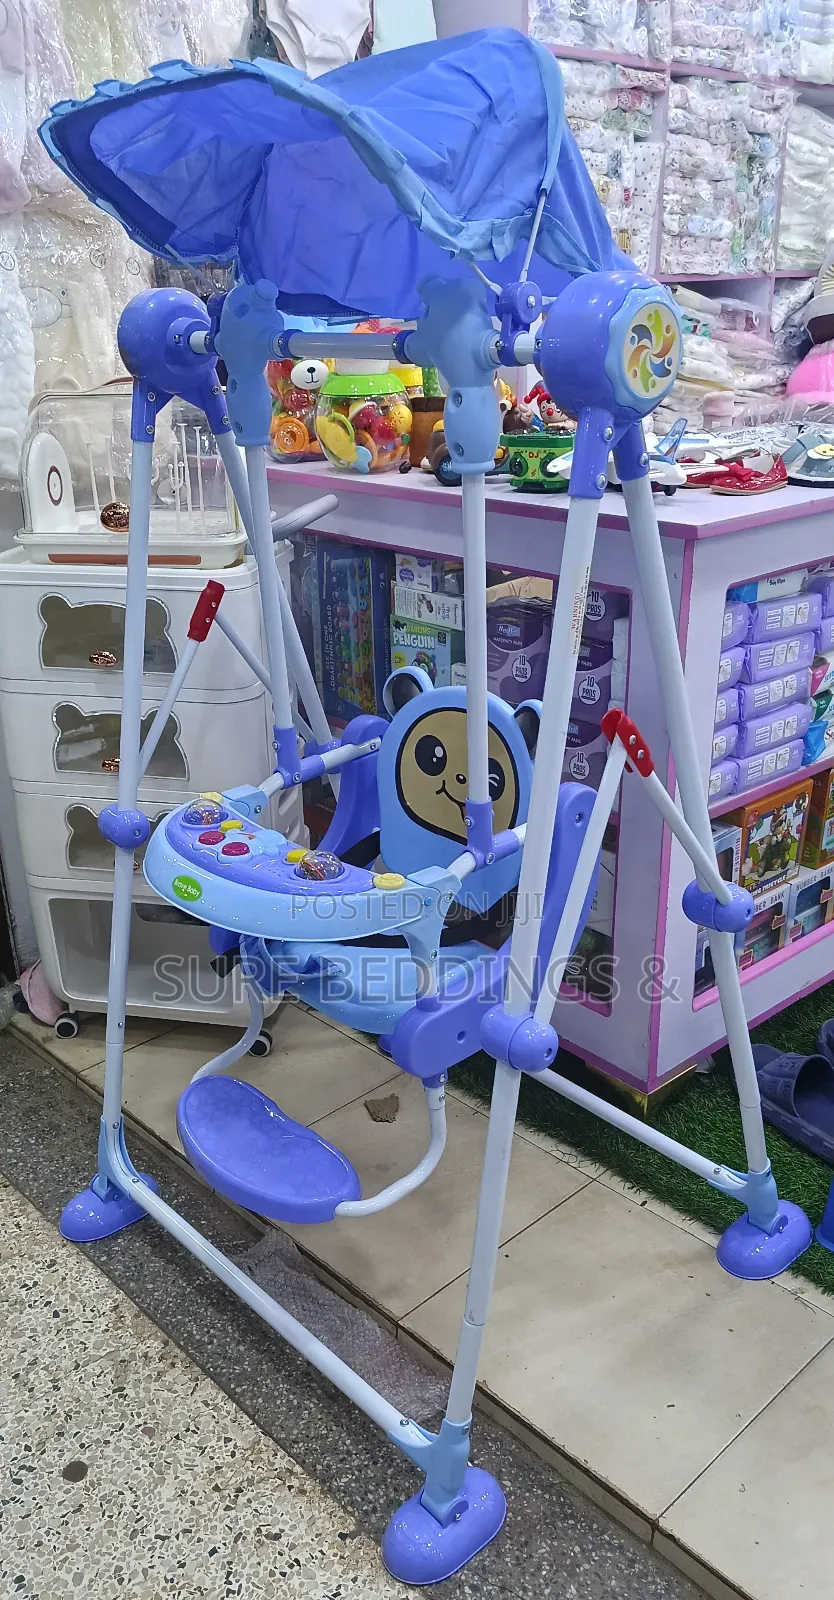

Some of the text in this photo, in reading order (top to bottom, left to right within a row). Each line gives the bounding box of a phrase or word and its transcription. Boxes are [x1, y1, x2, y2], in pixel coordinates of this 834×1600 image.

[528, 451, 540, 459] DJ
[591, 591, 600, 603] 10
[587, 603, 602, 614] PADS
[393, 631, 435, 650] PENGUIN
[518, 654, 526, 666] 10
[515, 665, 528, 676] PADS
[586, 675, 595, 688] 10
[582, 687, 597, 698] PADS
[576, 752, 585, 764] 10
[573, 763, 586, 774] PADS
[796, 867, 834, 891] NUMBER BANK
[186, 885, 201, 898] Baby
[770, 891, 785, 905] BANK
